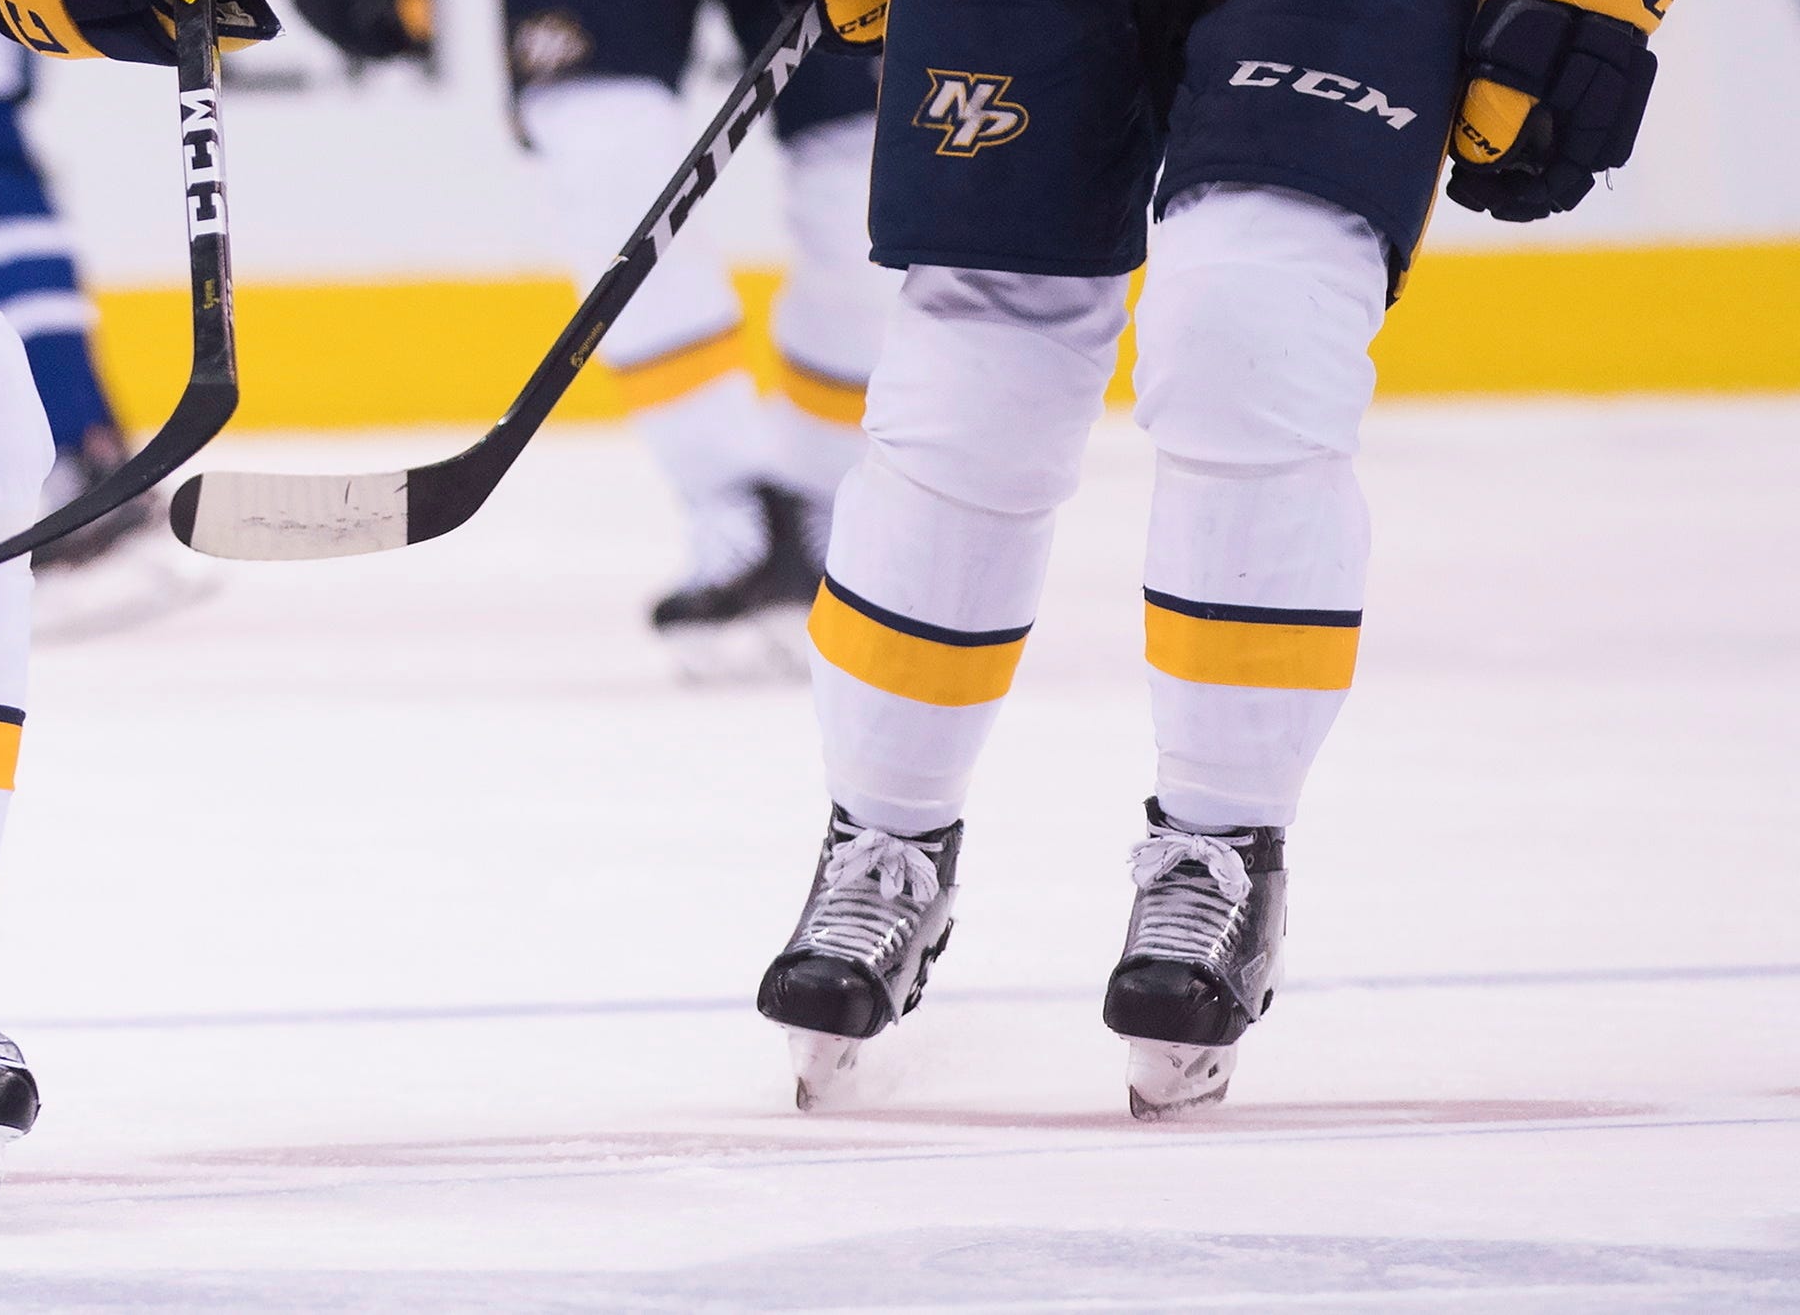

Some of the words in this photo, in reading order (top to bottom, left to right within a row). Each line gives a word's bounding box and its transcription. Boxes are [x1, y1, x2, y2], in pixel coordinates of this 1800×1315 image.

[179, 88, 228, 243] CCM
[644, 1, 823, 259] CCM
[1228, 60, 1418, 131] CCM
